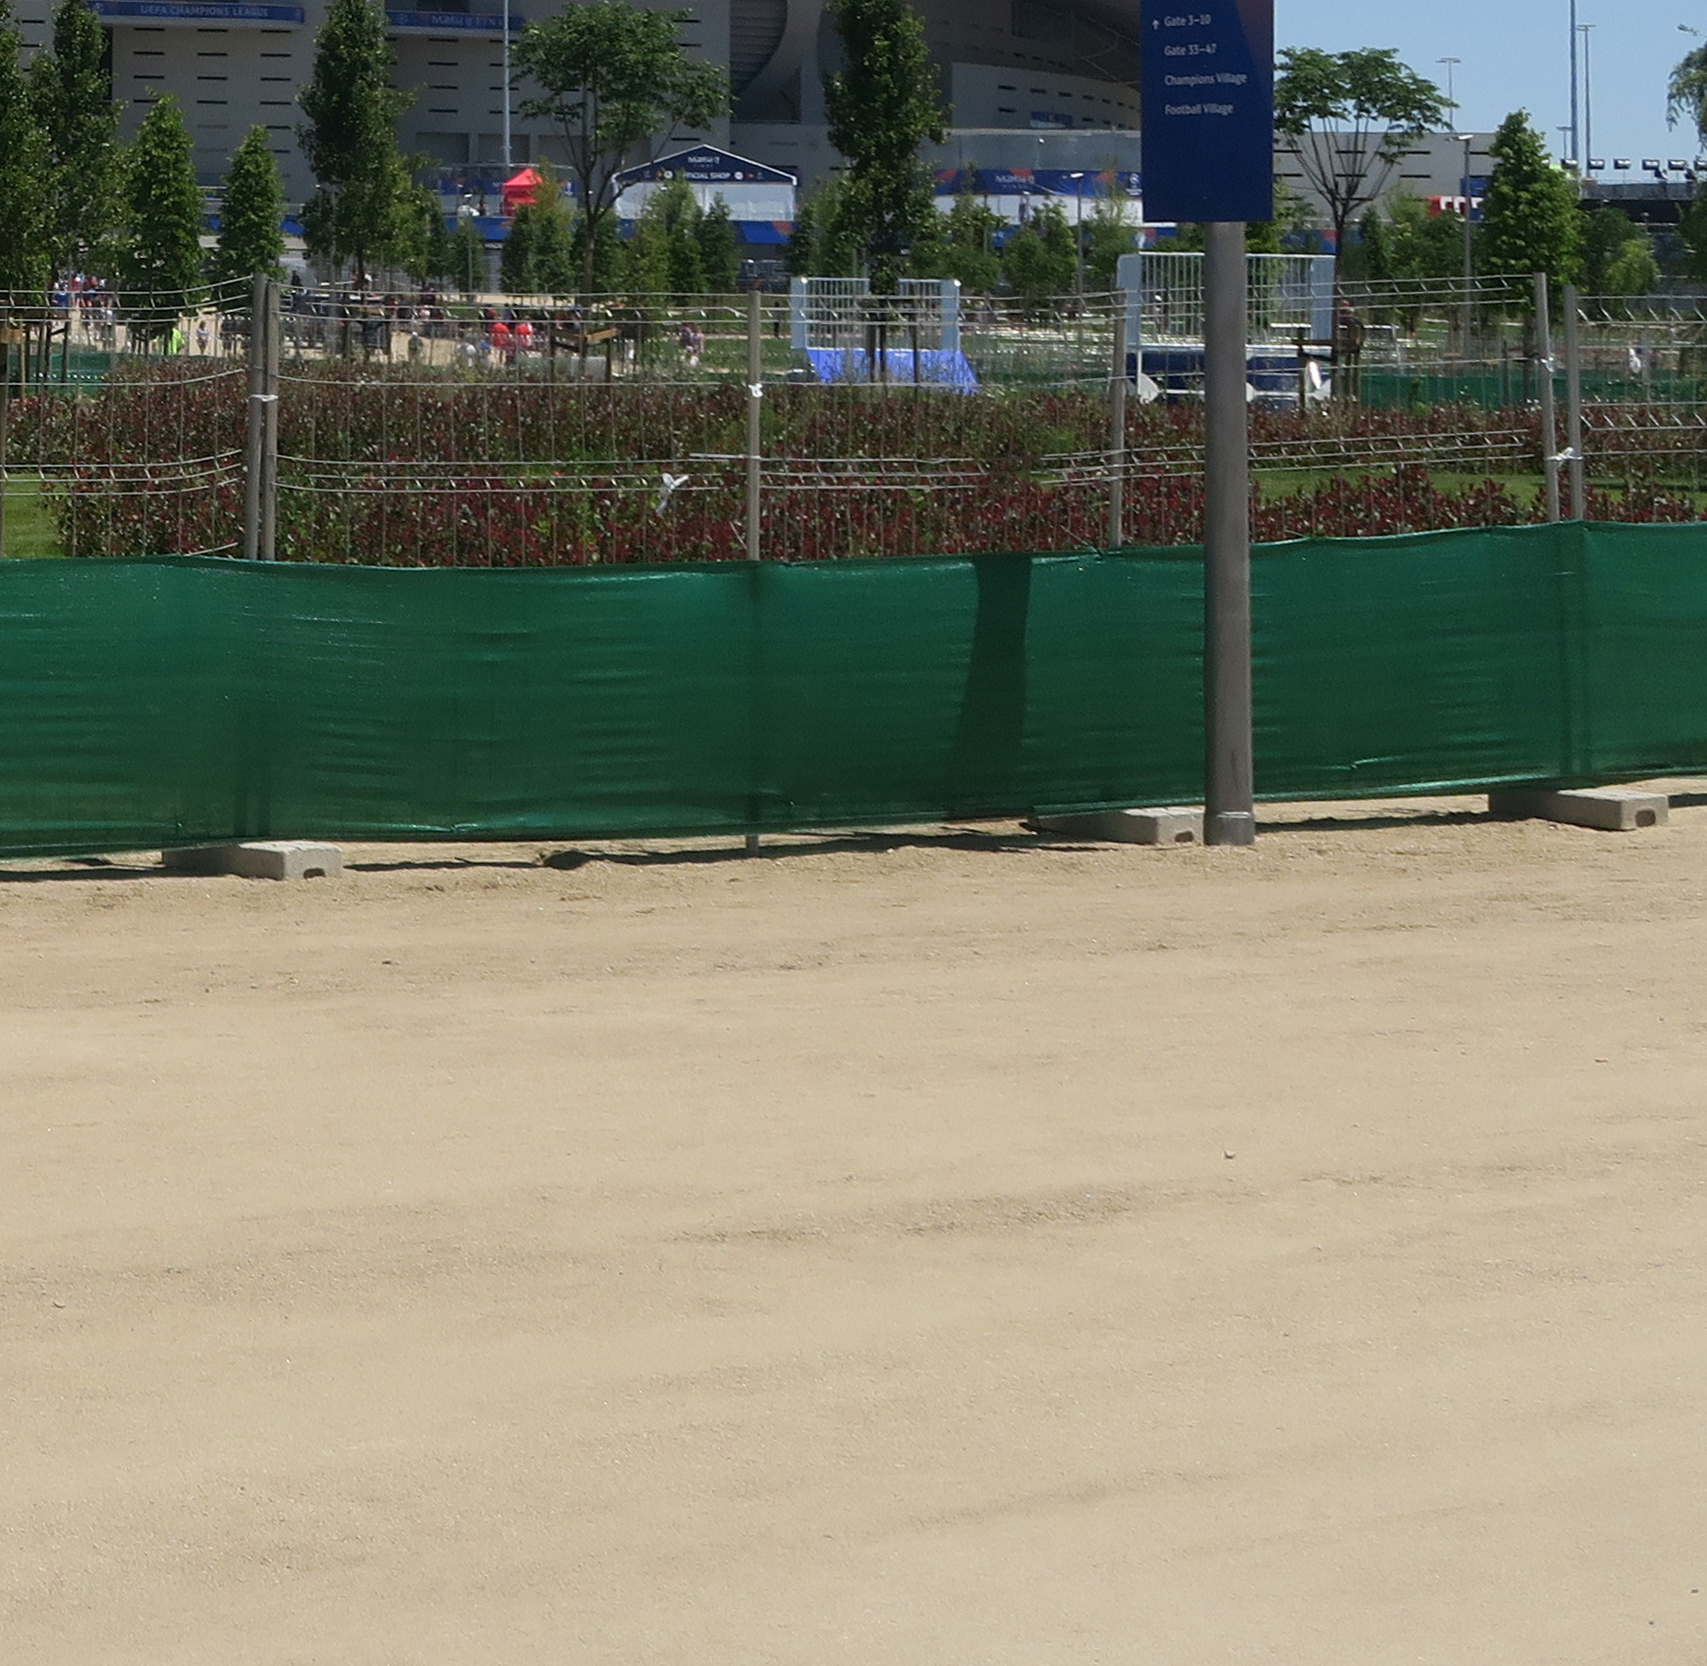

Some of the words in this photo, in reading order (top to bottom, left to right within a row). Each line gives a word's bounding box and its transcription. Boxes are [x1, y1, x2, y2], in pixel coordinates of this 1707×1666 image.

[139, 4, 168, 15] UEFA
[169, 5, 230, 17] CHAMPIONS
[232, 7, 269, 18] LEAGUE
[1163, 15, 1186, 26] Gate
[1163, 45, 1186, 56] Gate
[1164, 74, 1215, 87] Champions
[1215, 72, 1247, 85] Village
[1164, 104, 1202, 115] Football
[1203, 103, 1234, 116] Village
[709, 171, 731, 180] SHOP
